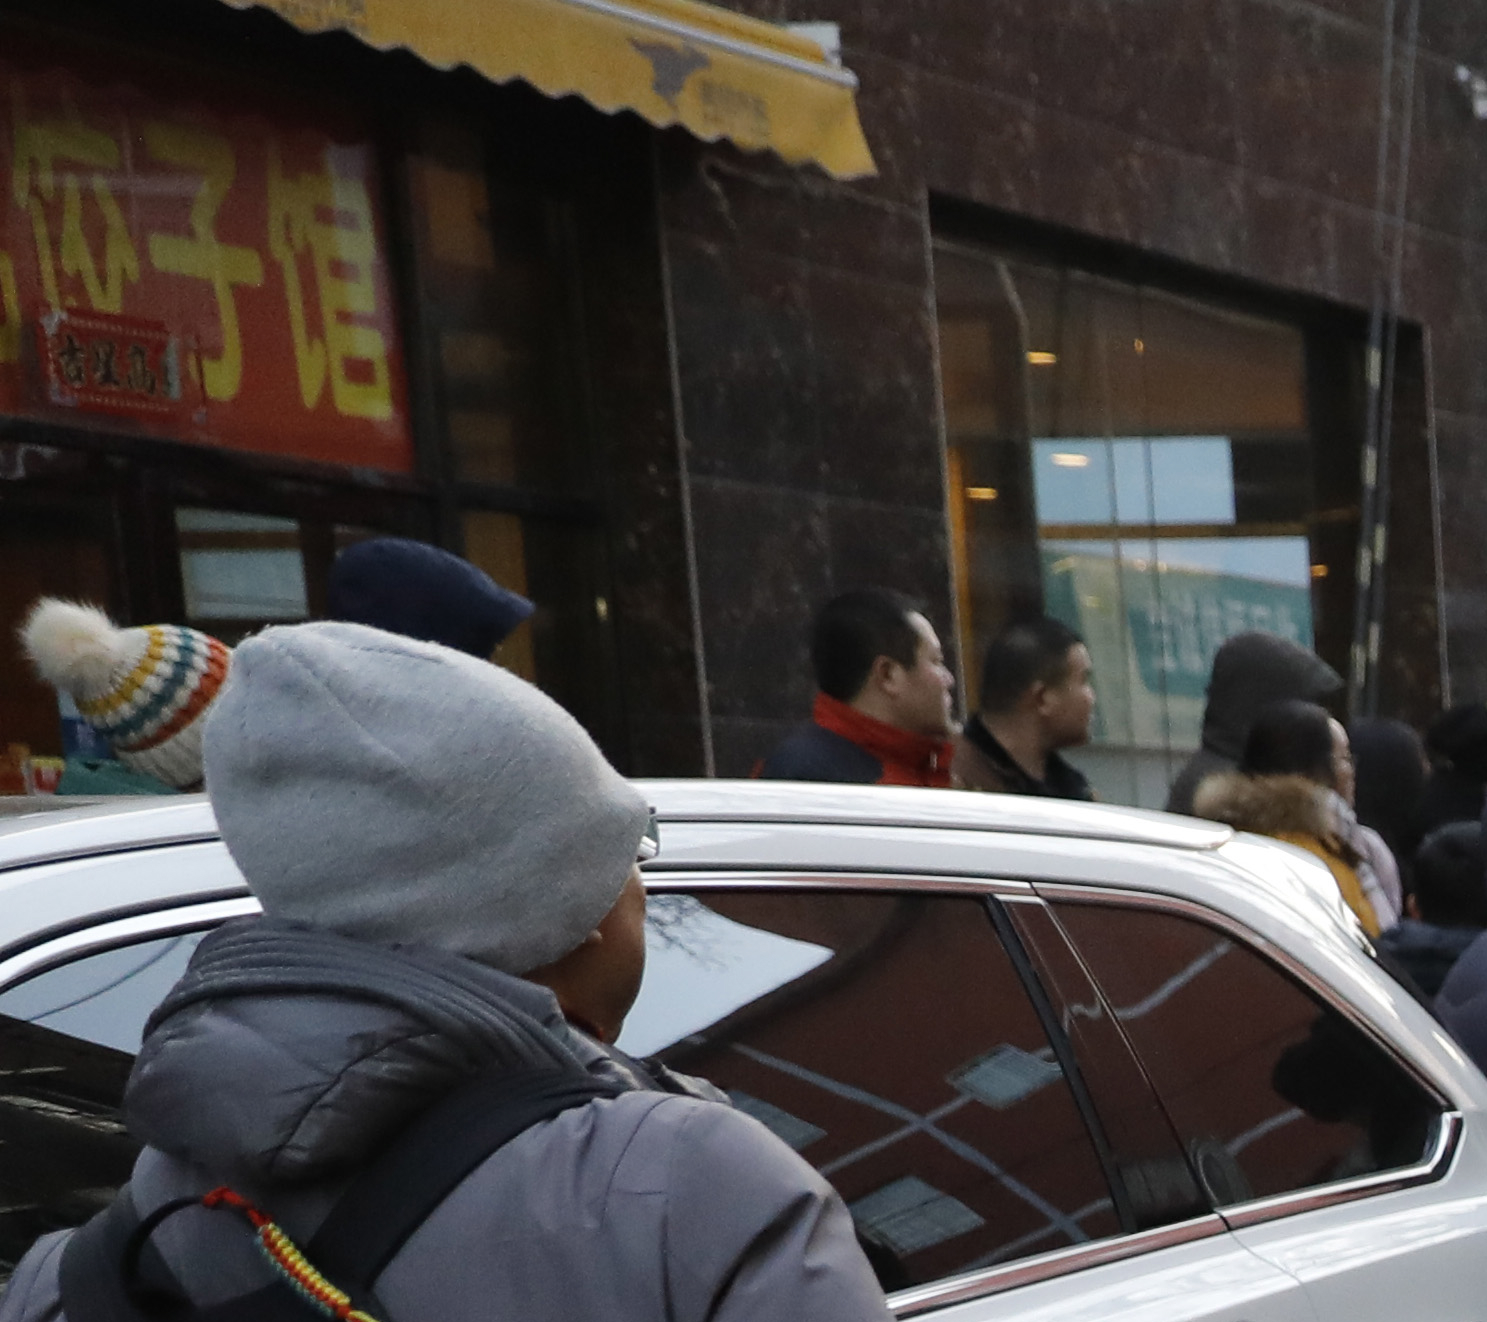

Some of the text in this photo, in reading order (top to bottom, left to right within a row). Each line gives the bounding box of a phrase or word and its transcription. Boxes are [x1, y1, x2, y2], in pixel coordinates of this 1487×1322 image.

[0, 124, 394, 421] 饺子馆
[59, 333, 180, 402] 吉星高
